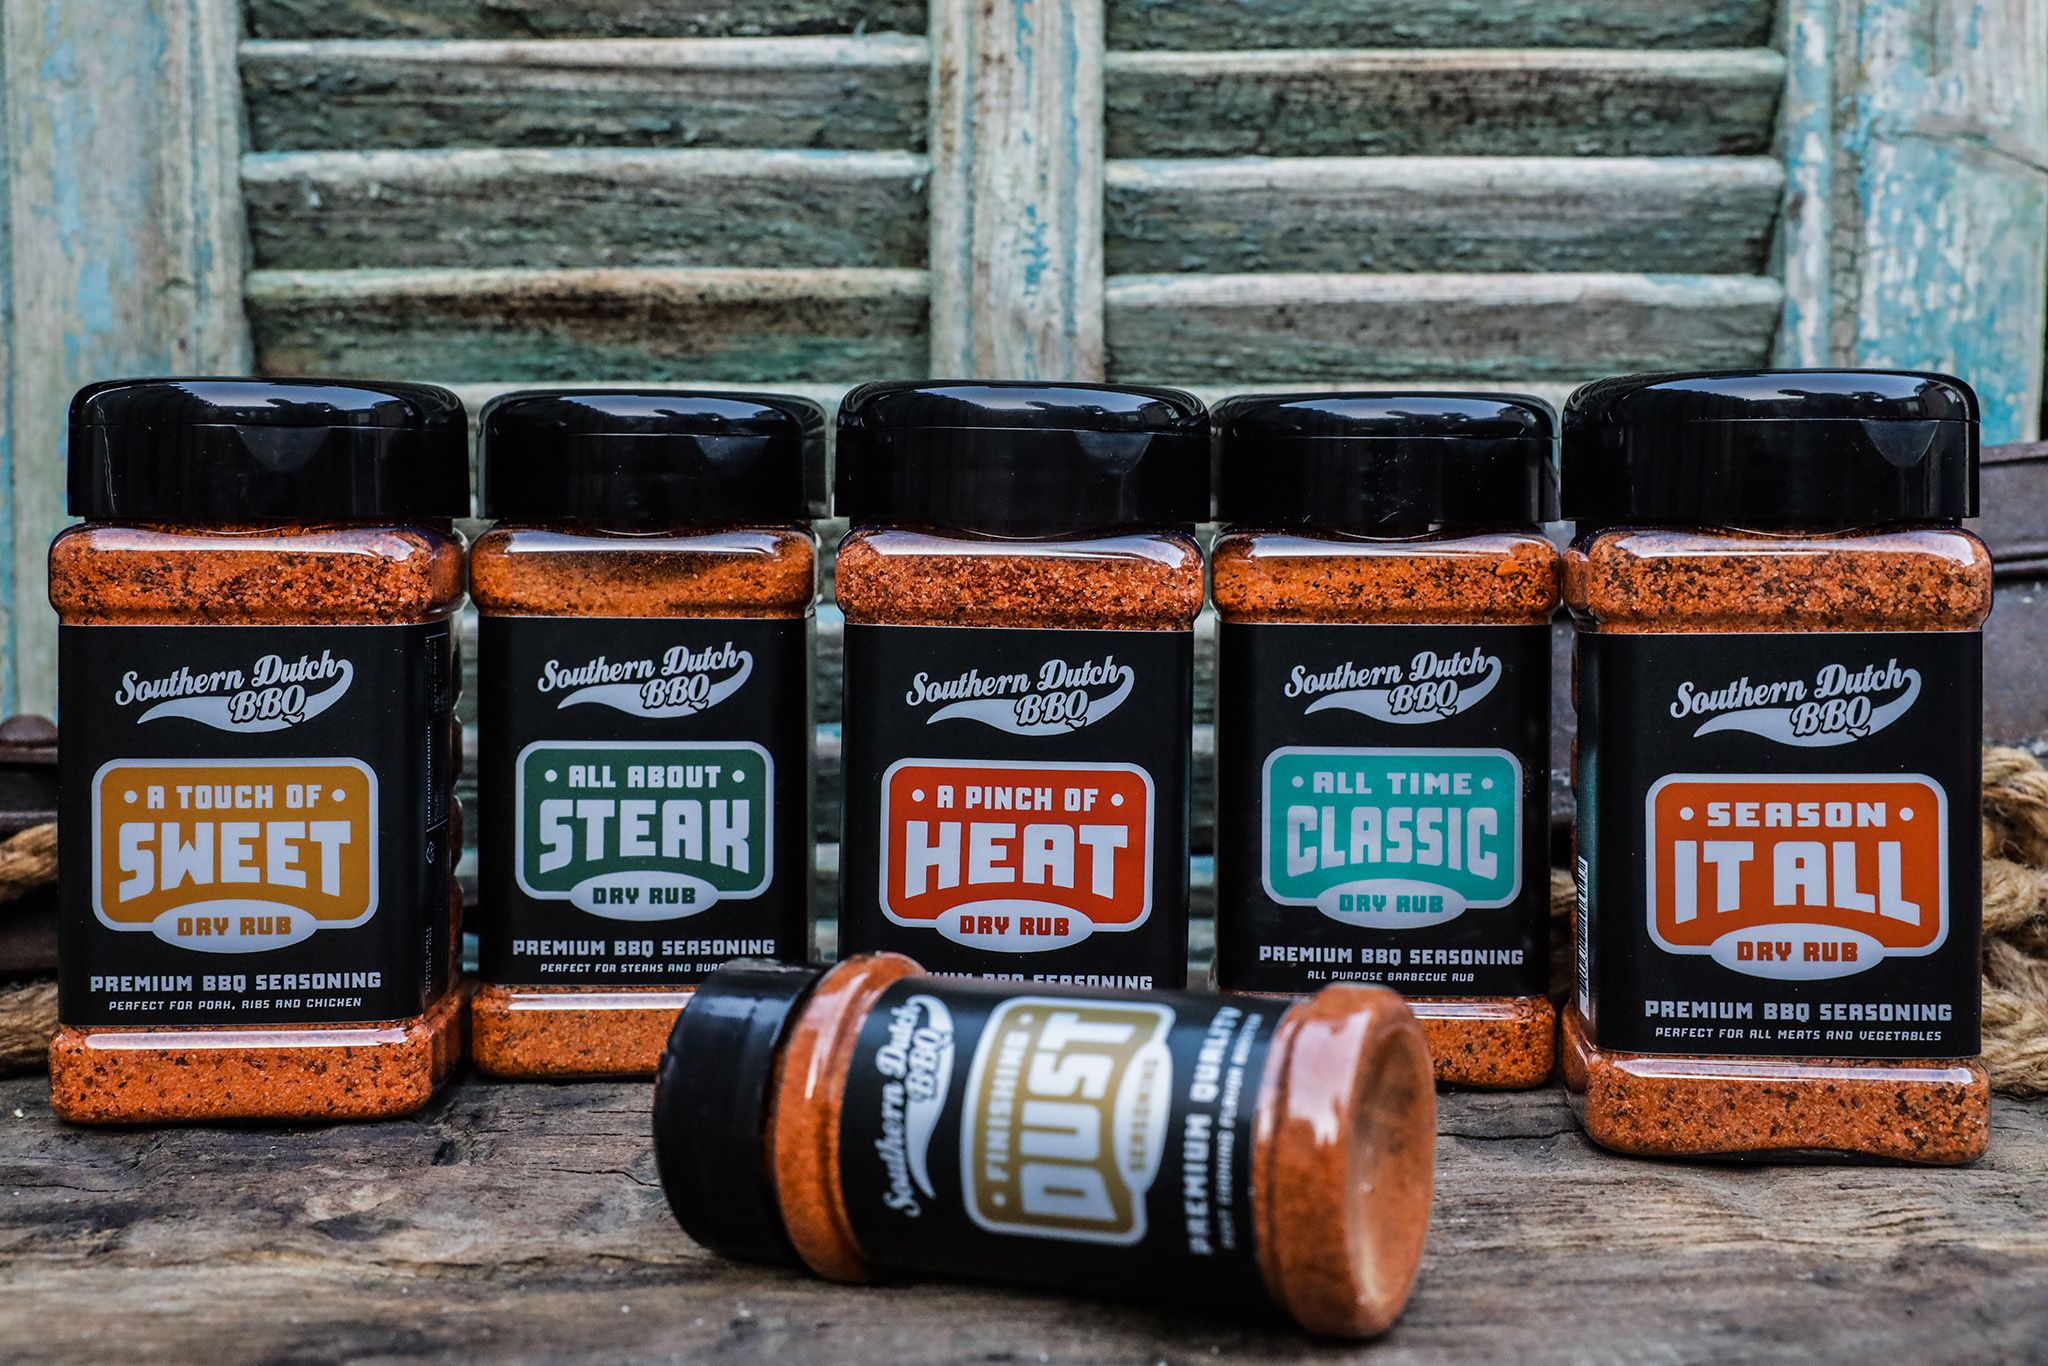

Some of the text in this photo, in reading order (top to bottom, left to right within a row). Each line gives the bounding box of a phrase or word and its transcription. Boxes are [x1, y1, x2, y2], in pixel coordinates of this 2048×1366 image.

[115, 650, 337, 706] Southern Dutch
[537, 641, 738, 692] Southern Dutch
[906, 655, 1119, 706] Southern Dutch
[1284, 647, 1487, 698] Southern Dutch
[228, 684, 308, 724] BBQ
[641, 674, 712, 711] BBQ
[1389, 679, 1460, 716] BBQ
[1670, 658, 1903, 718] Southern Dutch
[1015, 689, 1089, 727] BBQ
[1790, 696, 1874, 737] BBQ
[569, 765, 721, 788] ALL ABOUT
[1314, 772, 1472, 795] ALL TIME
[147, 784, 322, 809] A TOUCH OF
[937, 785, 1099, 812] A PINCH OF
[1707, 802, 1887, 827] SEASON
[540, 799, 749, 874] STEAK
[1287, 805, 1498, 880] CLASSIC
[119, 820, 351, 903] SWEET
[905, 820, 1128, 899] HEAT
[593, 887, 695, 904] DRY RUB
[1674, 840, 1921, 927] IT ALL
[1339, 894, 1443, 913] DRY RUB
[177, 916, 291, 936] DRY RUB
[960, 915, 1069, 936] DRY RUB
[513, 939, 775, 957] PREMIUM BBQ SEASONING
[1260, 946, 1524, 966] PREMIUM BBQ SEASONING
[1737, 941, 1858, 962] DRY RUB
[90, 972, 381, 993] PREMIUM BBQ SEASONING
[541, 964, 591, 973] PERFECT
[595, 964, 616, 973] FOR
[620, 963, 664, 973] STEAKS
[668, 963, 691, 973] AND
[1033, 974, 1153, 991] SEASONING
[1308, 971, 1474, 982] ALL PURPOSE BARBECUE RUB
[109, 1001, 165, 1011] PERFECT
[169, 1000, 193, 1010] FOR
[242, 999, 270, 1009] RIBS
[275, 999, 301, 1009] AND
[306, 997, 361, 1008] CHICKEN
[1645, 1001, 1952, 1023] PREMIUM BBQ SEASONING
[1656, 1027, 1942, 1041] PERFECT FOR ALL MEATS AND VEGETABLES
[905, 1025, 952, 1102] BBQ
[875, 997, 921, 1219] Southern Dutch
[985, 1031, 1031, 1182] FINISHING
[1019, 1010, 1137, 1220] DUST
[1183, 1006, 1242, 1256] PREMIUM QUALITY
